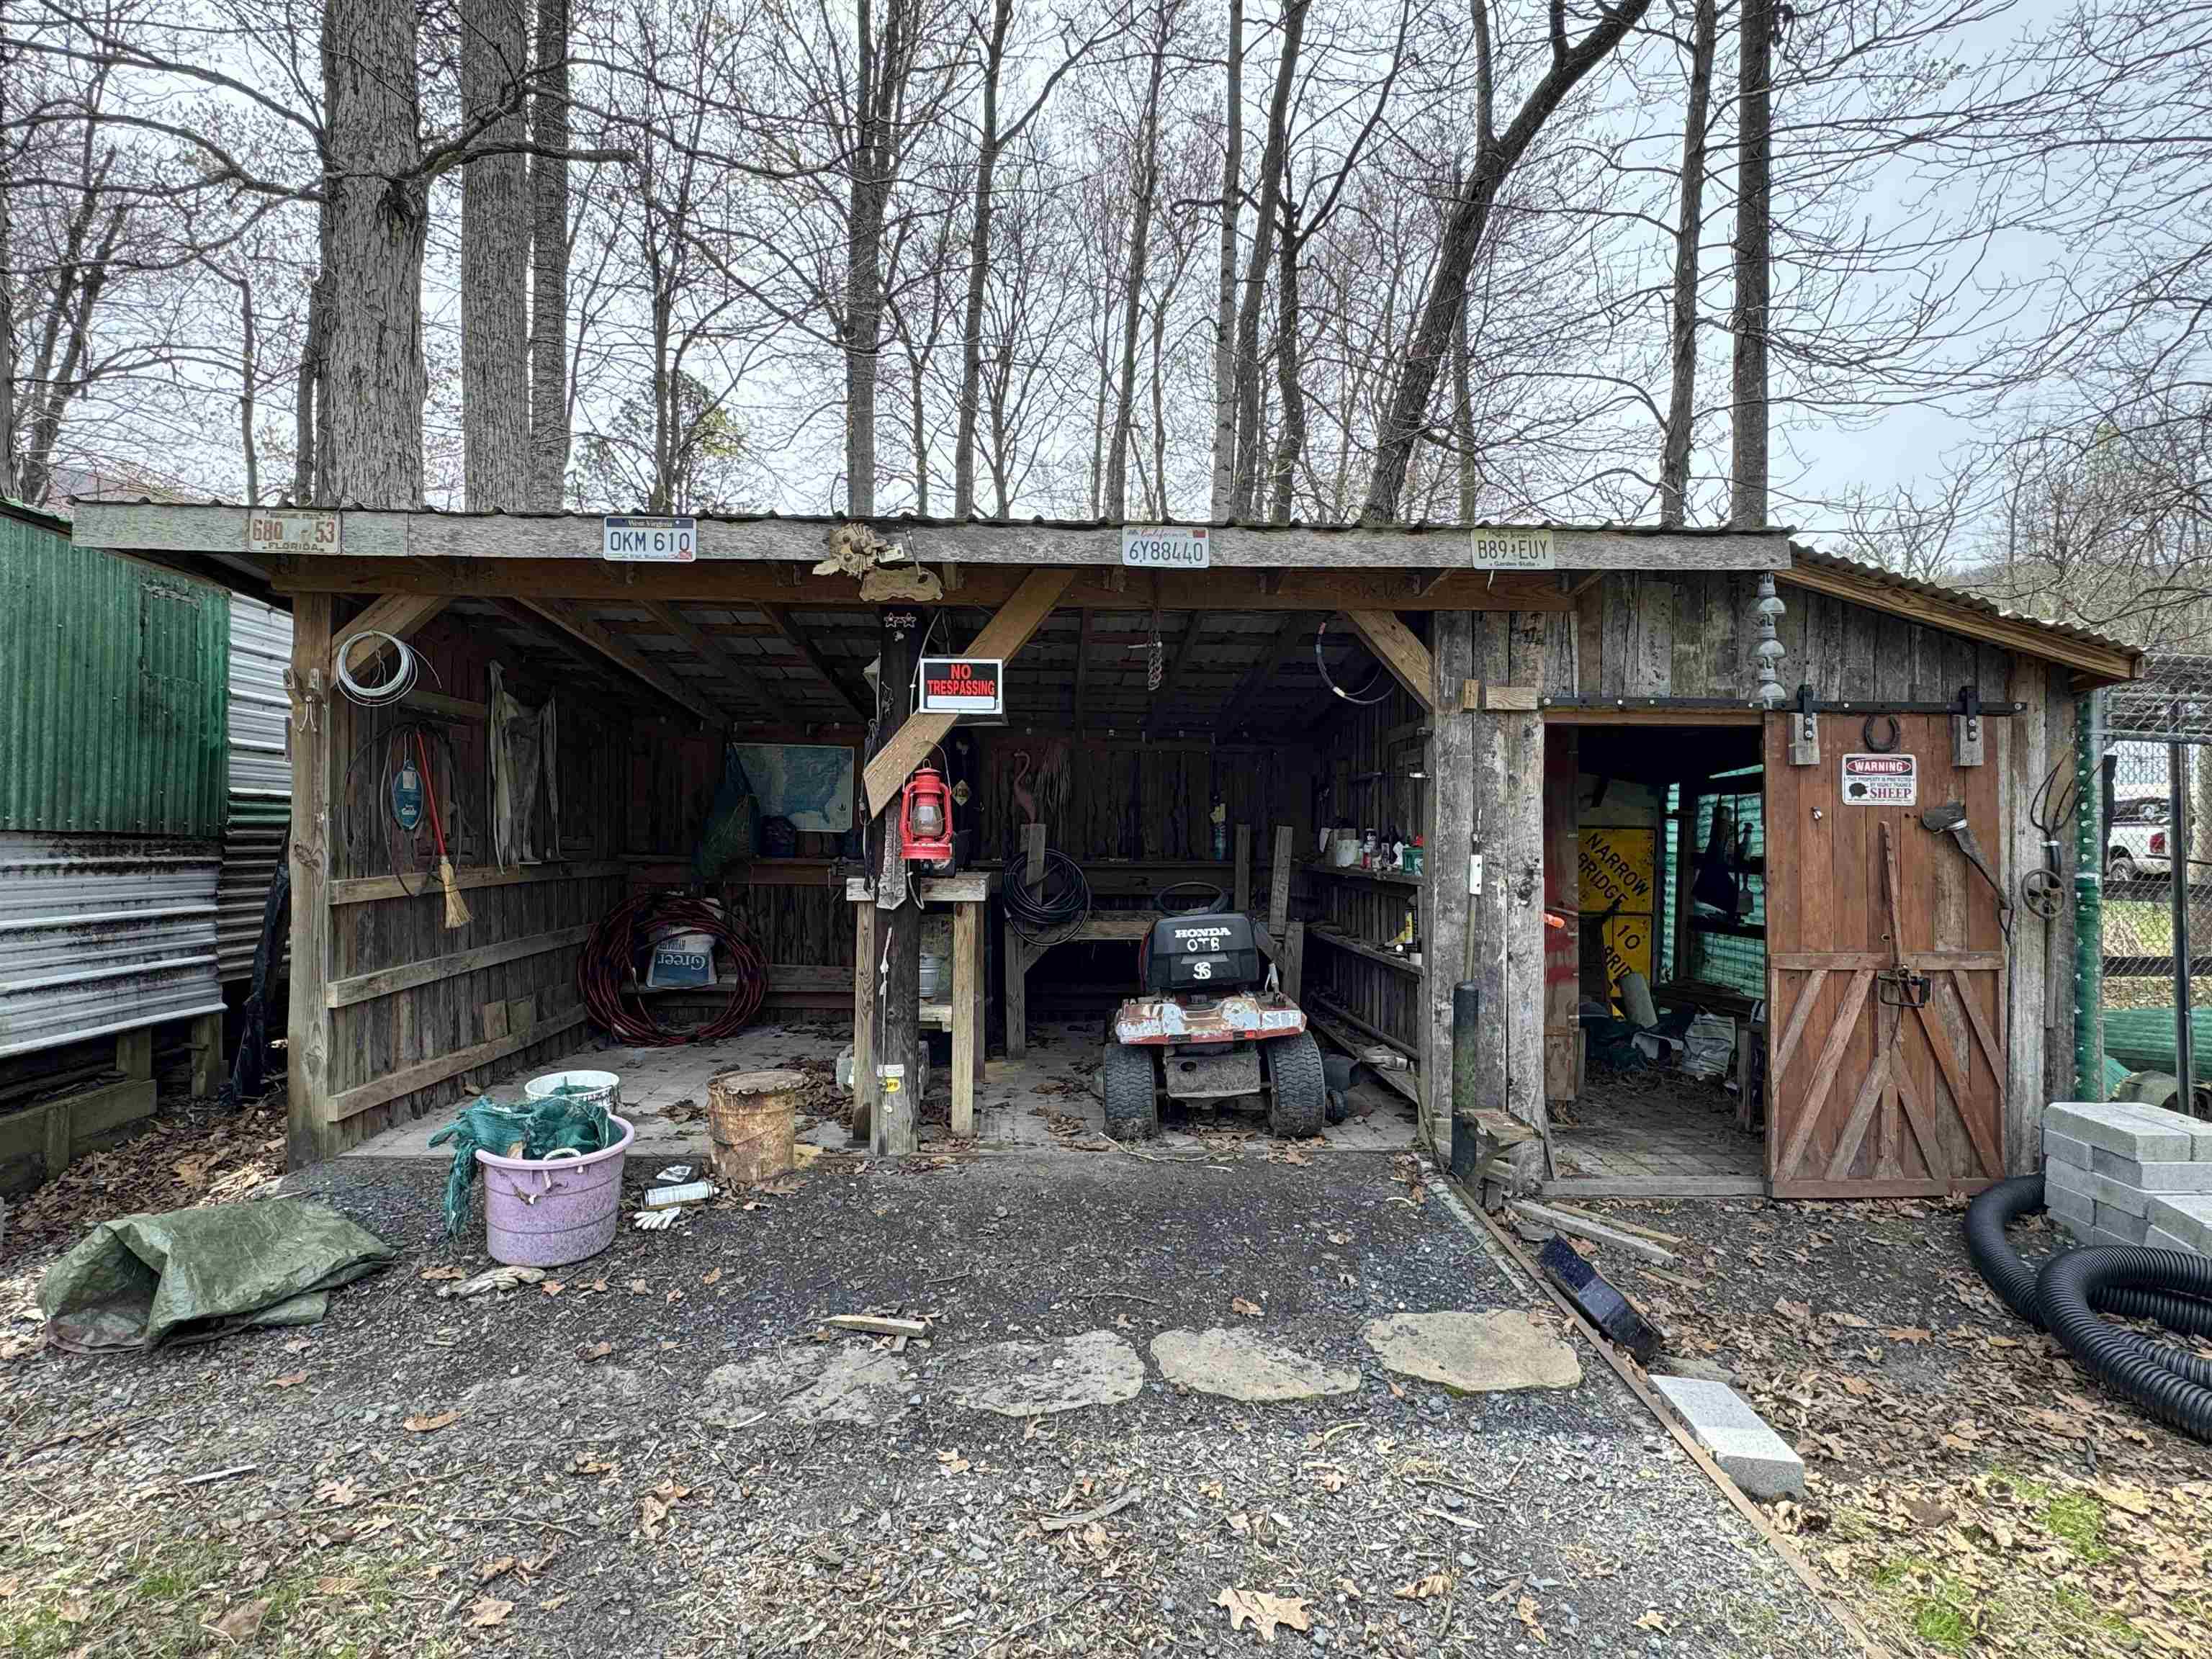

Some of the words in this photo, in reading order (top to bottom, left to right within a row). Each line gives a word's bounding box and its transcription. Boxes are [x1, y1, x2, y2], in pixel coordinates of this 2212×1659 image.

[628, 518, 645, 527] West
[646, 518, 673, 529] Virginia
[1140, 528, 1187, 541] California
[268, 541, 318, 550] FLORIDA
[654, 532, 691, 552] 610
[1129, 541, 1203, 562] 6Y88440
[950, 664, 972, 679] NO
[927, 680, 995, 696] TRESPASSING
[1854, 761, 1903, 773] WARNING
[1869, 788, 1912, 799] SHEEP
[1585, 833, 1649, 897] NARROW
[1174, 927, 1232, 939] HONDA
[1617, 925, 1641, 951] 10
